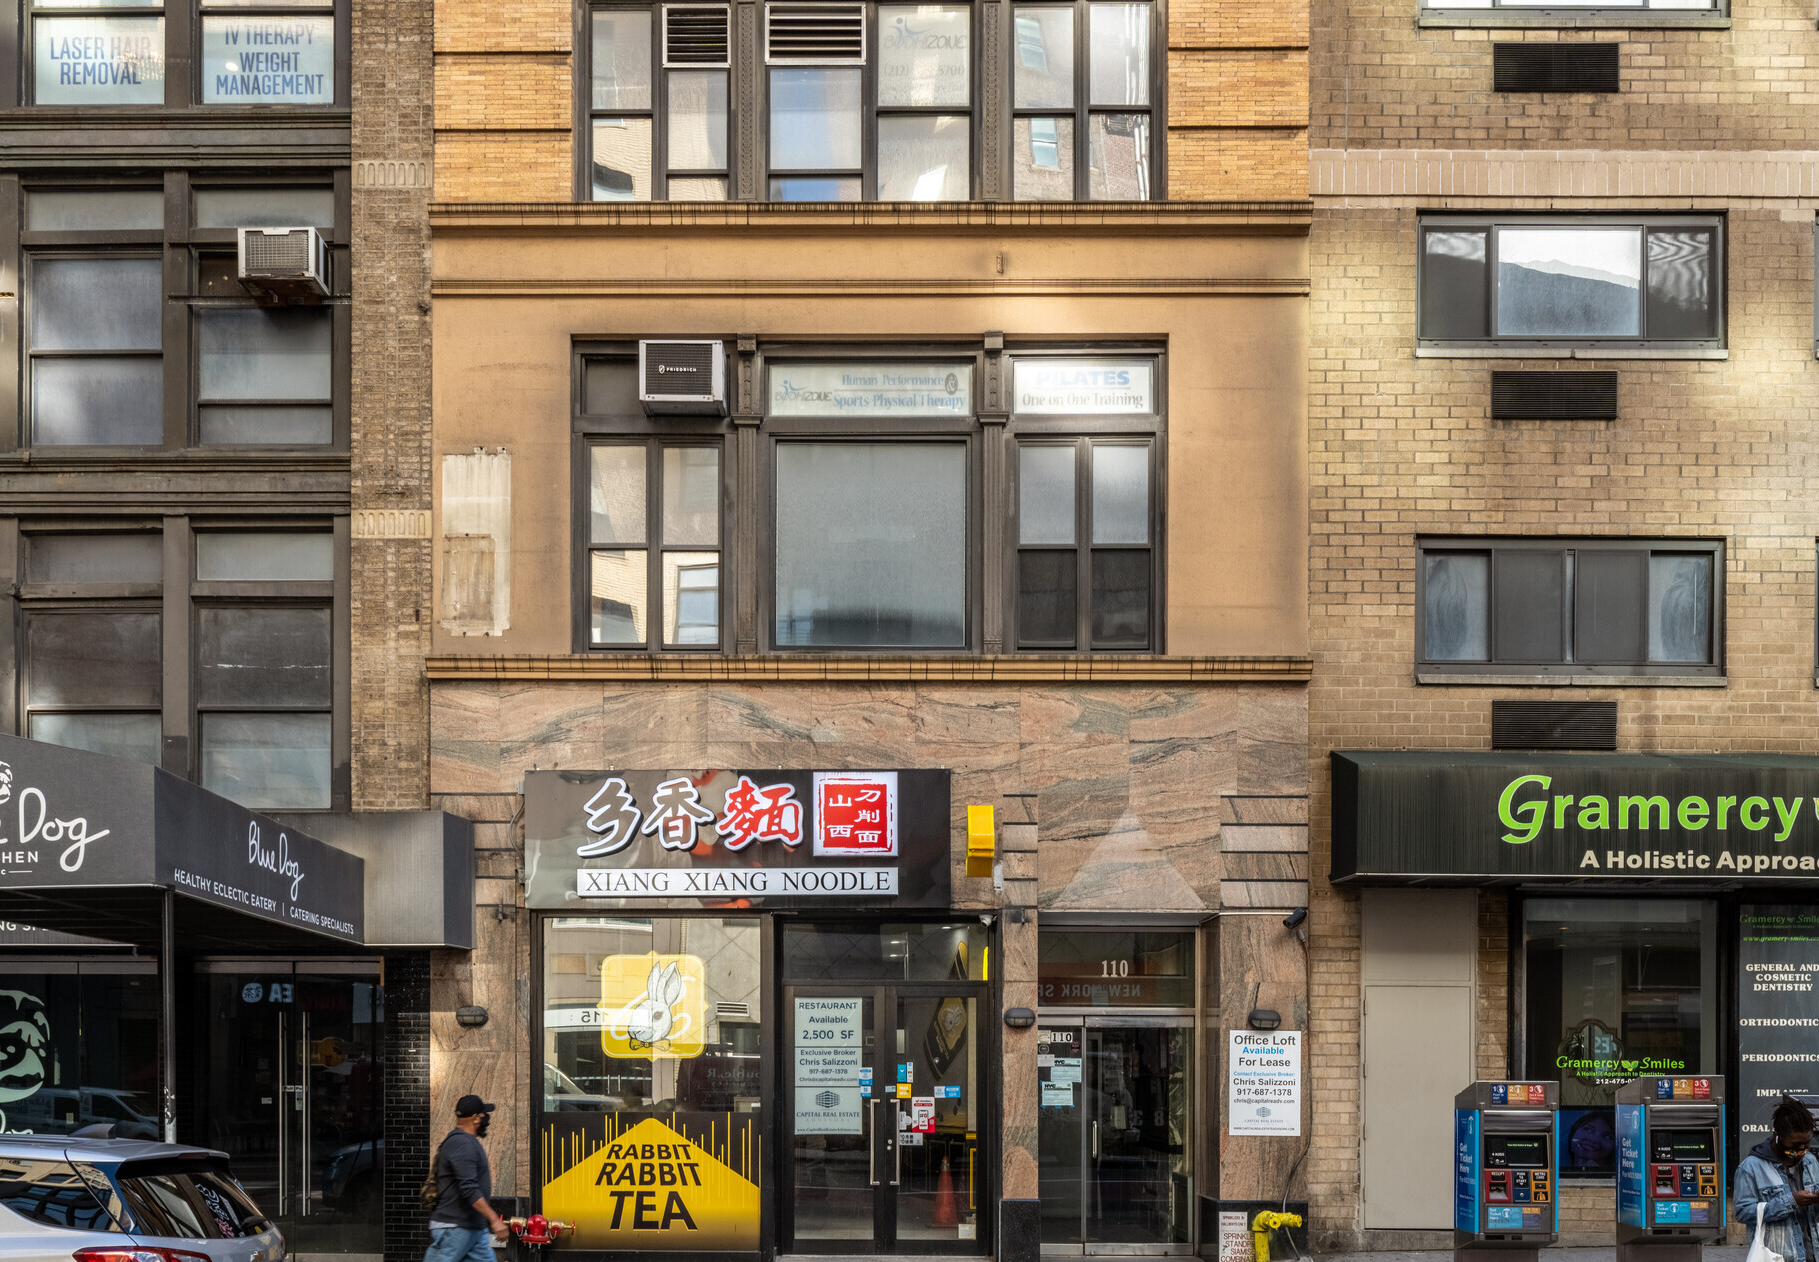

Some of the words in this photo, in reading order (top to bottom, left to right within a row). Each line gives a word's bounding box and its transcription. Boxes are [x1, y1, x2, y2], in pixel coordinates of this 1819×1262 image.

[225, 25, 239, 45] IV
[245, 25, 313, 45] THERAPY
[51, 37, 104, 60] LASER
[111, 36, 152, 61] HAIR
[240, 52, 300, 73] WEIGHT
[60, 62, 141, 85] REMOVAL
[216, 74, 324, 95] MANAGEMENT
[842, 374, 878, 386] Human
[883, 374, 944, 386] Performance
[1036, 370, 1130, 386] PILATES
[834, 395, 869, 410] Sports
[873, 394, 917, 410] Physical
[920, 394, 965, 410] Therapy
[1022, 393, 1045, 406] One
[1049, 396, 1064, 406] on
[1067, 393, 1090, 406] One
[1092, 392, 1143, 409] Training
[1498, 774, 1803, 844] Gramercy
[19, 787, 110, 872] Dog
[248, 820, 277, 872] Blue
[279, 832, 305, 901] Dog
[1580, 850, 1600, 868] A
[1607, 851, 1710, 869] Holistic
[585, 872, 670, 892] XIANG
[683, 872, 768, 892] XIANG
[782, 872, 890, 892] NOODLE
[174, 868, 212, 892] HEALTHY
[213, 881, 249, 904] ECLECTIC
[251, 894, 277, 912] EATERY
[290, 906, 320, 925] CATERING
[320, 916, 354, 935] SPECIALISTS
[1740, 914, 1785, 924] Gramercy
[1101, 960, 1129, 978] 110
[1745, 964, 1795, 972] GENERAL
[1800, 964, 1819, 972] AND
[1753, 983, 1813, 991] DENTISTRY
[808, 1016, 848, 1024] Available
[803, 1030, 834, 1040] 2,500
[841, 1030, 854, 1039] SF
[1052, 1033, 1072, 1041] 110
[1234, 1035, 1269, 1045] Office
[1273, 1036, 1296, 1045] Loft
[1242, 1046, 1285, 1055] Available
[822, 1058, 858, 1066] Salizzoni
[1239, 1057, 1256, 1066] For
[1260, 1058, 1291, 1067] Lease
[1556, 1056, 1619, 1070] Gramercy
[1640, 1057, 1685, 1069] Smiles
[1236, 1088, 1292, 1096] 917-687-1378
[1621, 1138, 1631, 1147] Get
[606, 1144, 690, 1160] RABBIT
[1460, 1153, 1473, 1164] Ticket
[1622, 1148, 1639, 1158] Ticket
[1460, 1163, 1470, 1173] Here
[1622, 1158, 1634, 1168] Here
[595, 1163, 702, 1186] RABBIT
[610, 1191, 698, 1230] TEA
